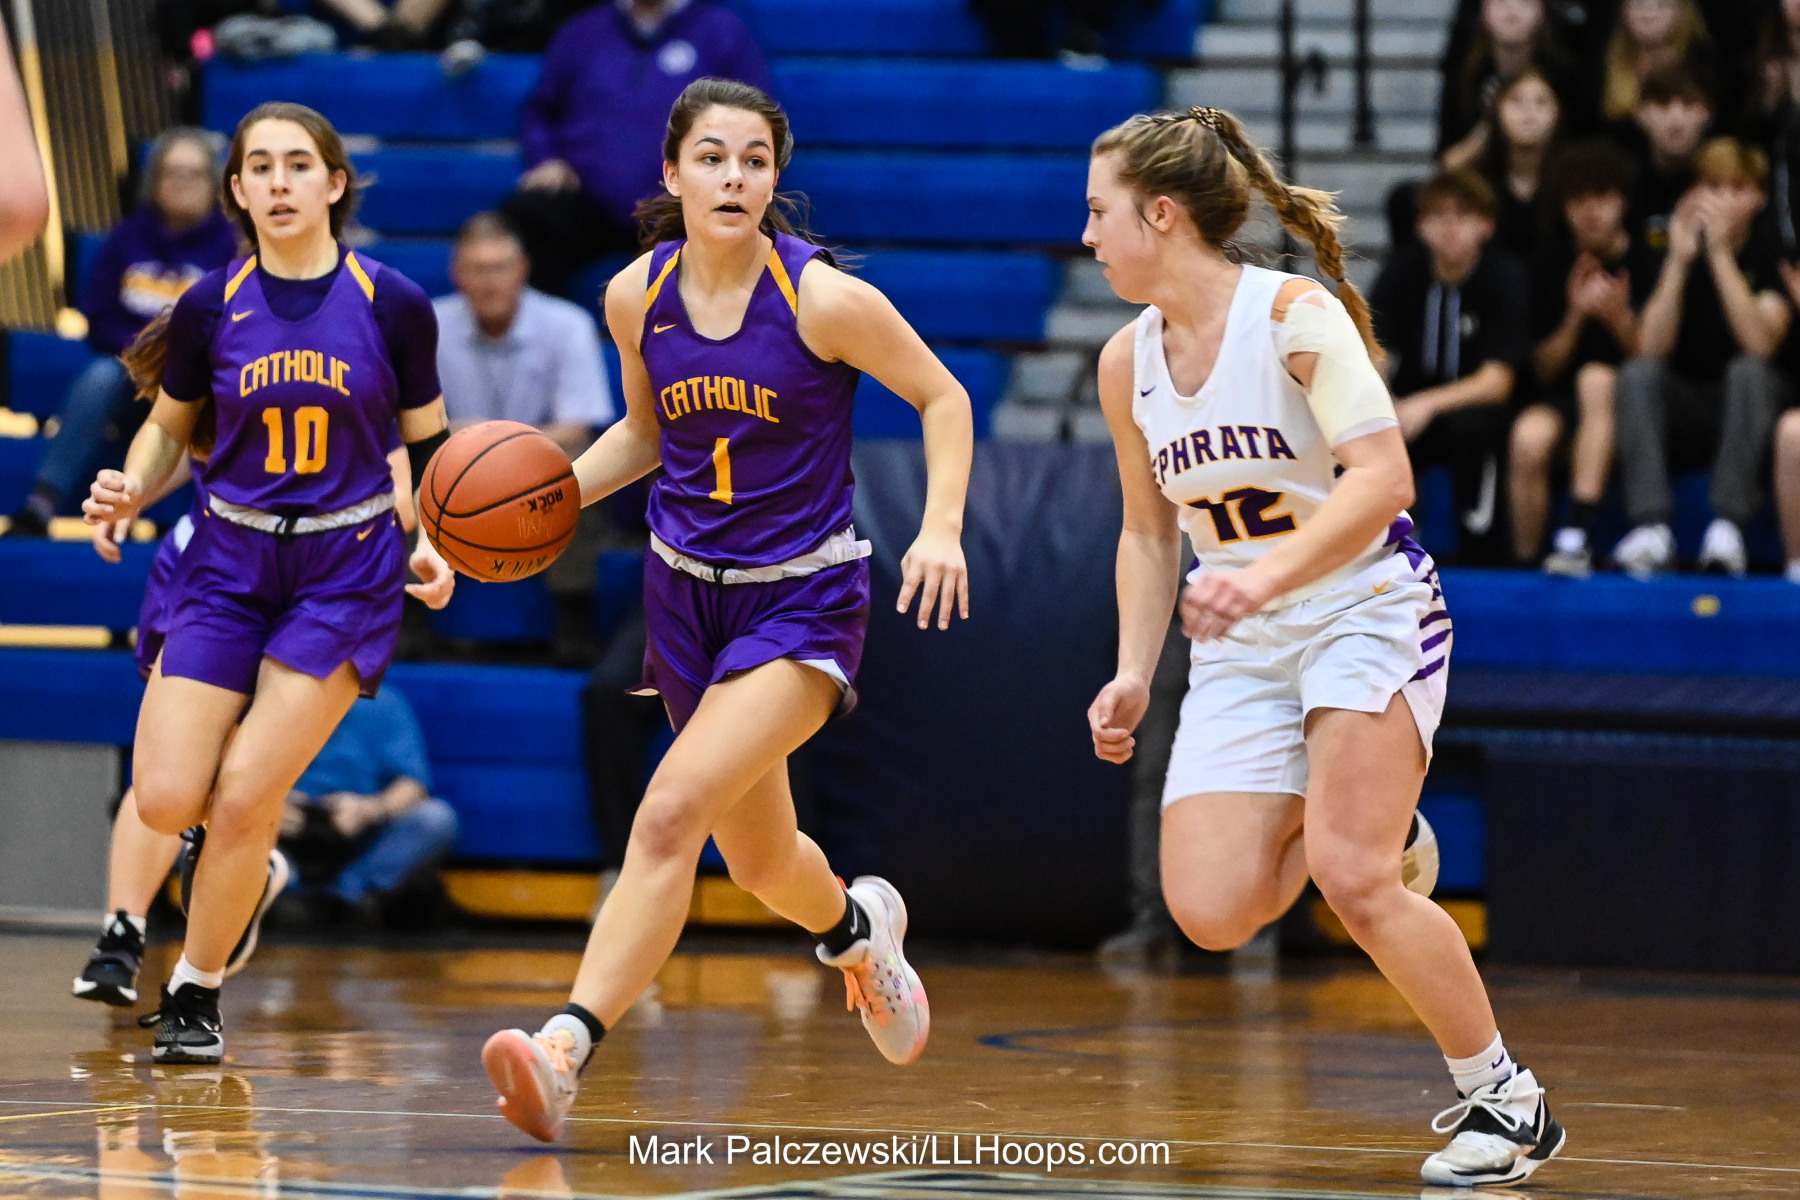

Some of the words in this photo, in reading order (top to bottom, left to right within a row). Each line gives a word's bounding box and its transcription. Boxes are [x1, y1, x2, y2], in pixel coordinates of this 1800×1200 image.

[240, 349, 351, 397] CATHOLIC
[660, 375, 780, 423] CATHOLIC
[262, 405, 329, 474] 10
[709, 437, 735, 505] 1
[528, 488, 563, 512] ROCK
[1185, 486, 1297, 544] 12
